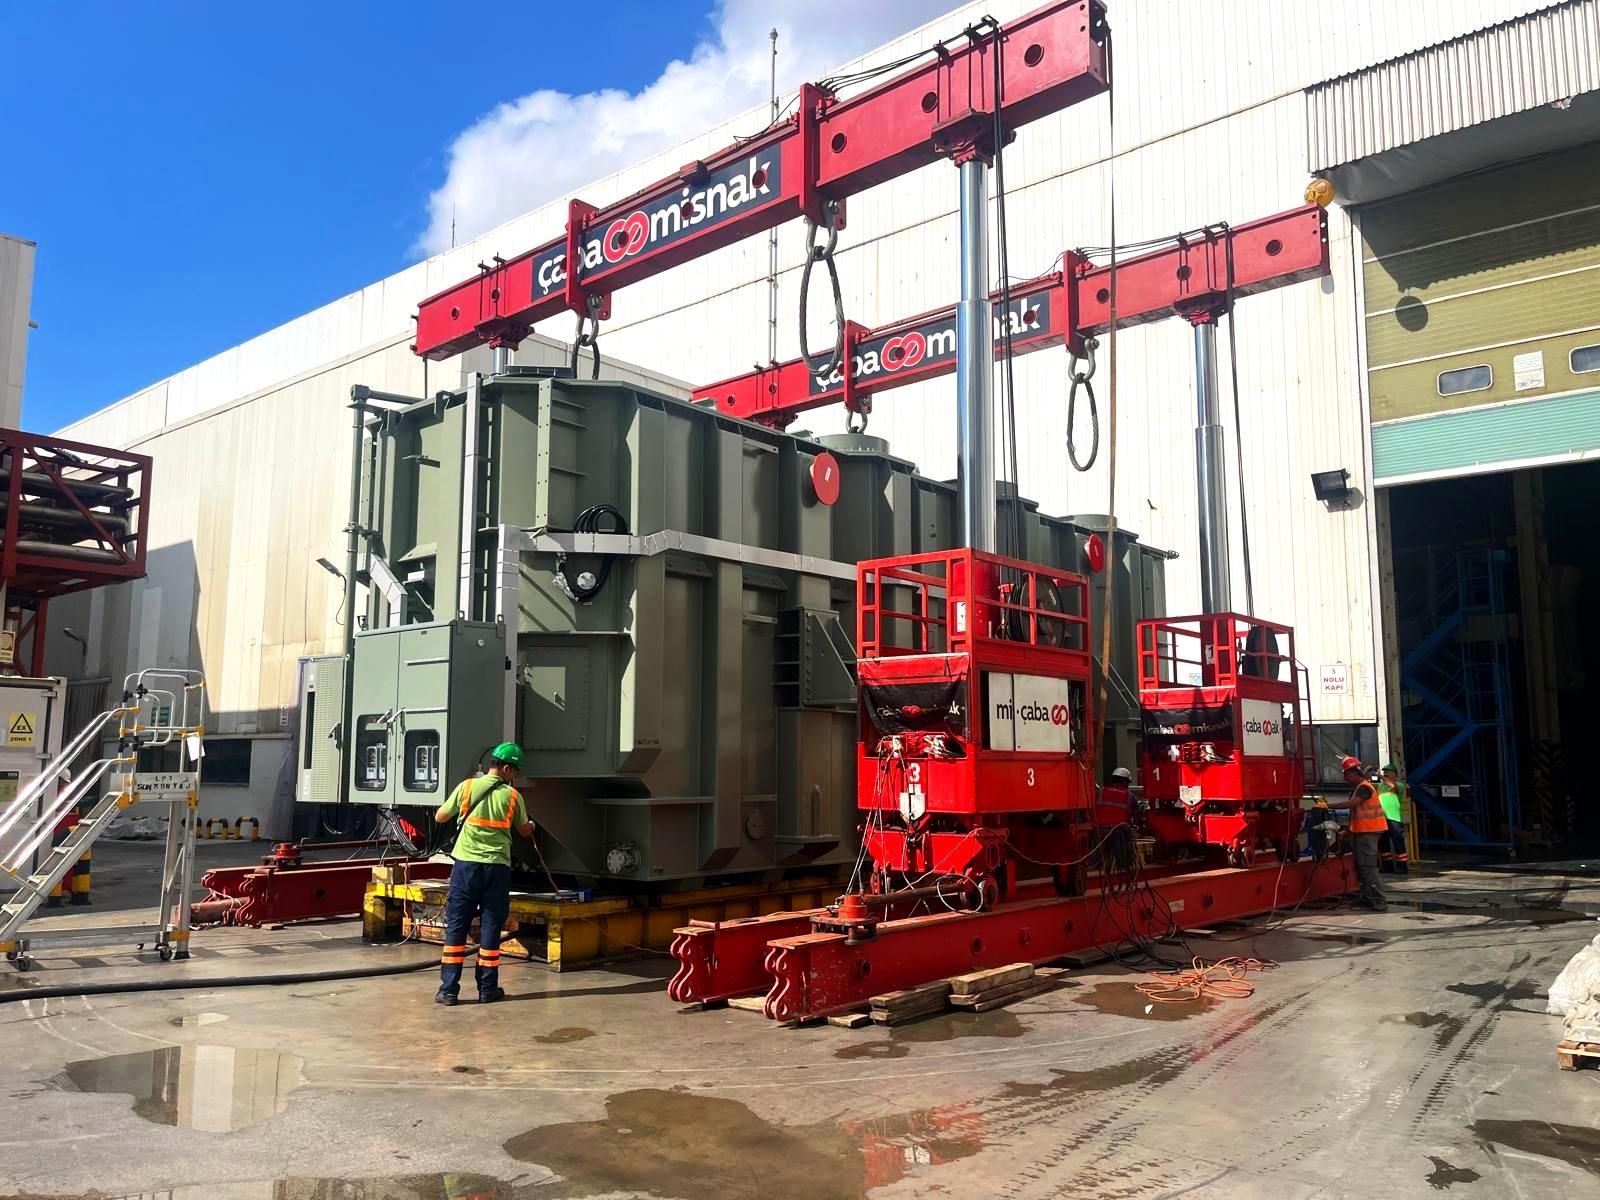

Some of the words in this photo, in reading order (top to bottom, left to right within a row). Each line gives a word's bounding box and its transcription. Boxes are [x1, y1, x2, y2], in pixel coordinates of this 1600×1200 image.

[1020, 700, 1050, 725] çaba
[1246, 718, 1262, 735] çaba
[909, 762, 921, 782] 3
[1027, 767, 1035, 787] 3
[1153, 767, 1160, 781] 1
[1272, 769, 1277, 784] 1
